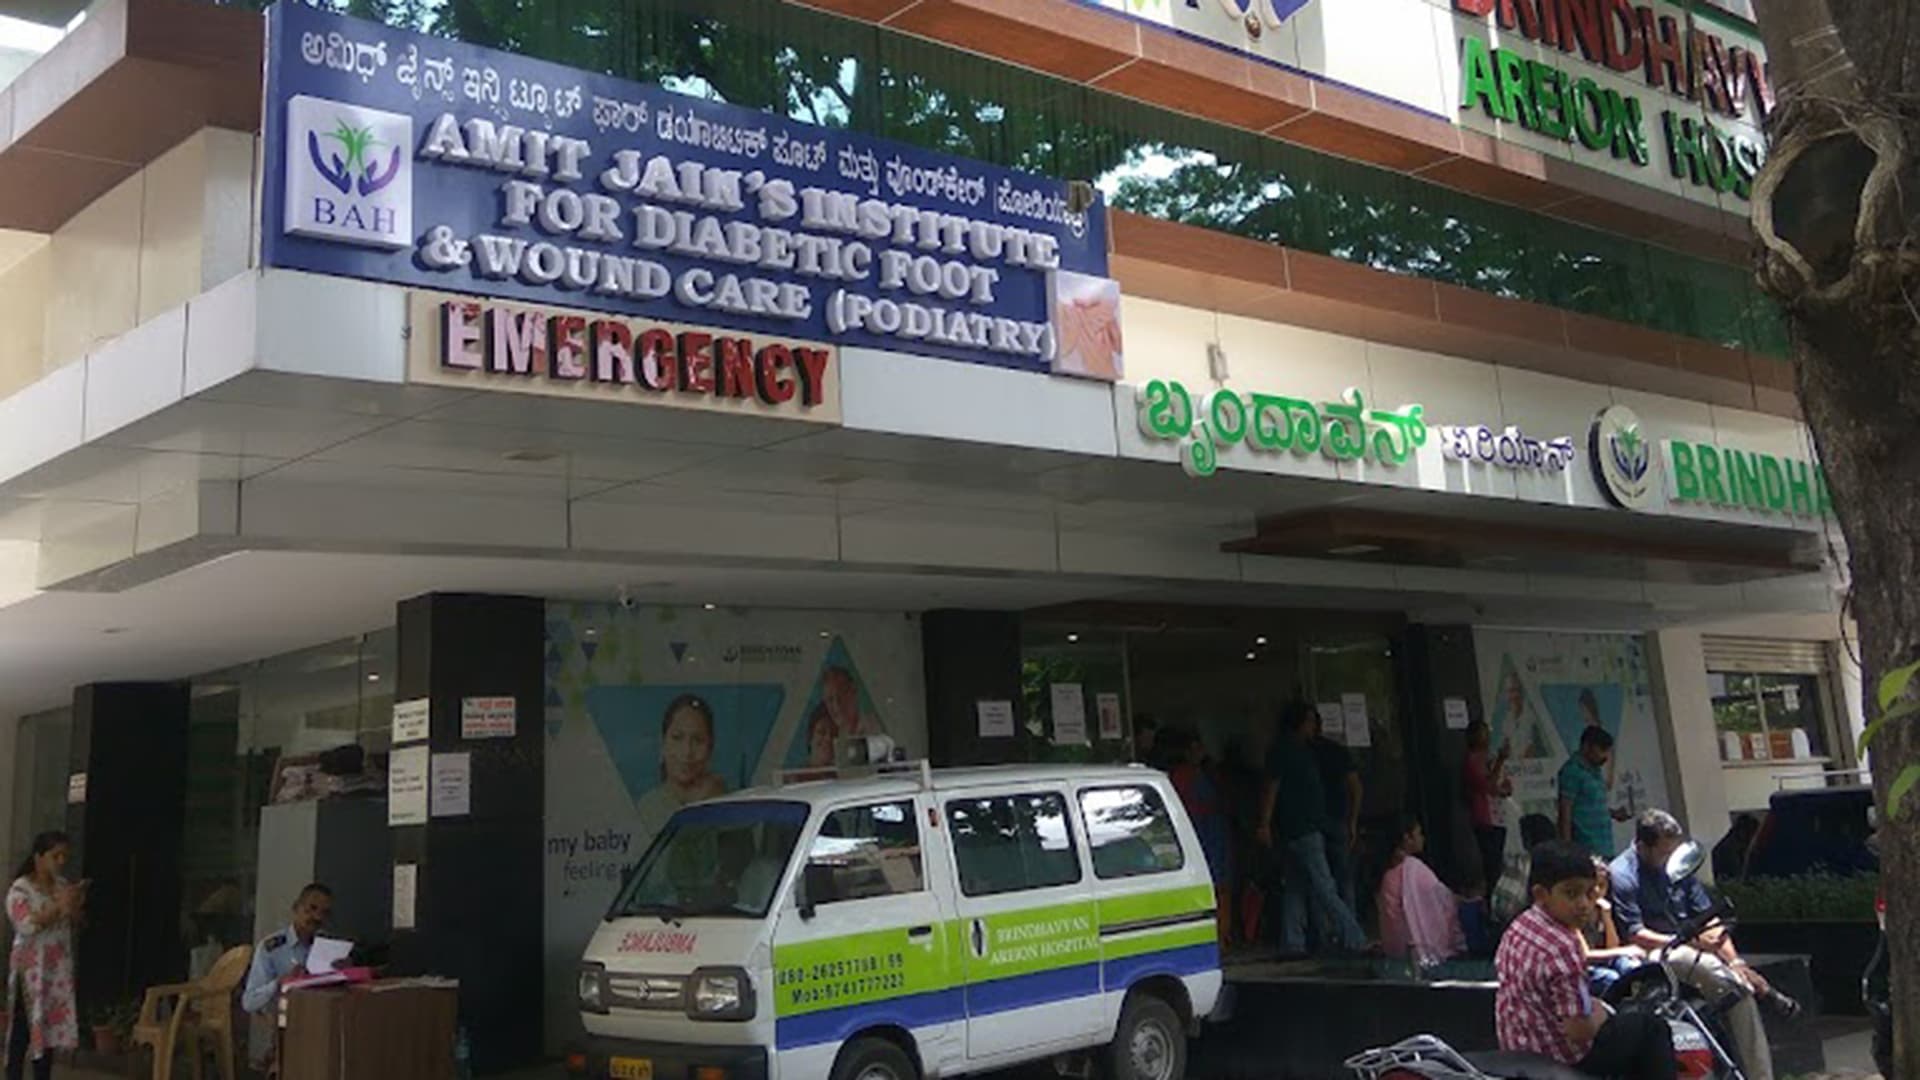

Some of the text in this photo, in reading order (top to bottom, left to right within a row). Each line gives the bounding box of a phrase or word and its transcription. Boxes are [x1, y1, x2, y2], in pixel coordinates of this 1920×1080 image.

[1459, 35, 1648, 167] AREION
[313, 197, 397, 235] BAH
[421, 113, 1060, 269] AMIT JAIN'S INSTITUTE
[838, 144, 880, 196] ಮತ್ತು
[420, 224, 1056, 362] & WOUND CARE (PODIATRY)
[501, 179, 999, 304] FOR DIABETIC FOOT
[439, 300, 830, 406] EMERGENCY
[547, 828, 632, 857] my baby
